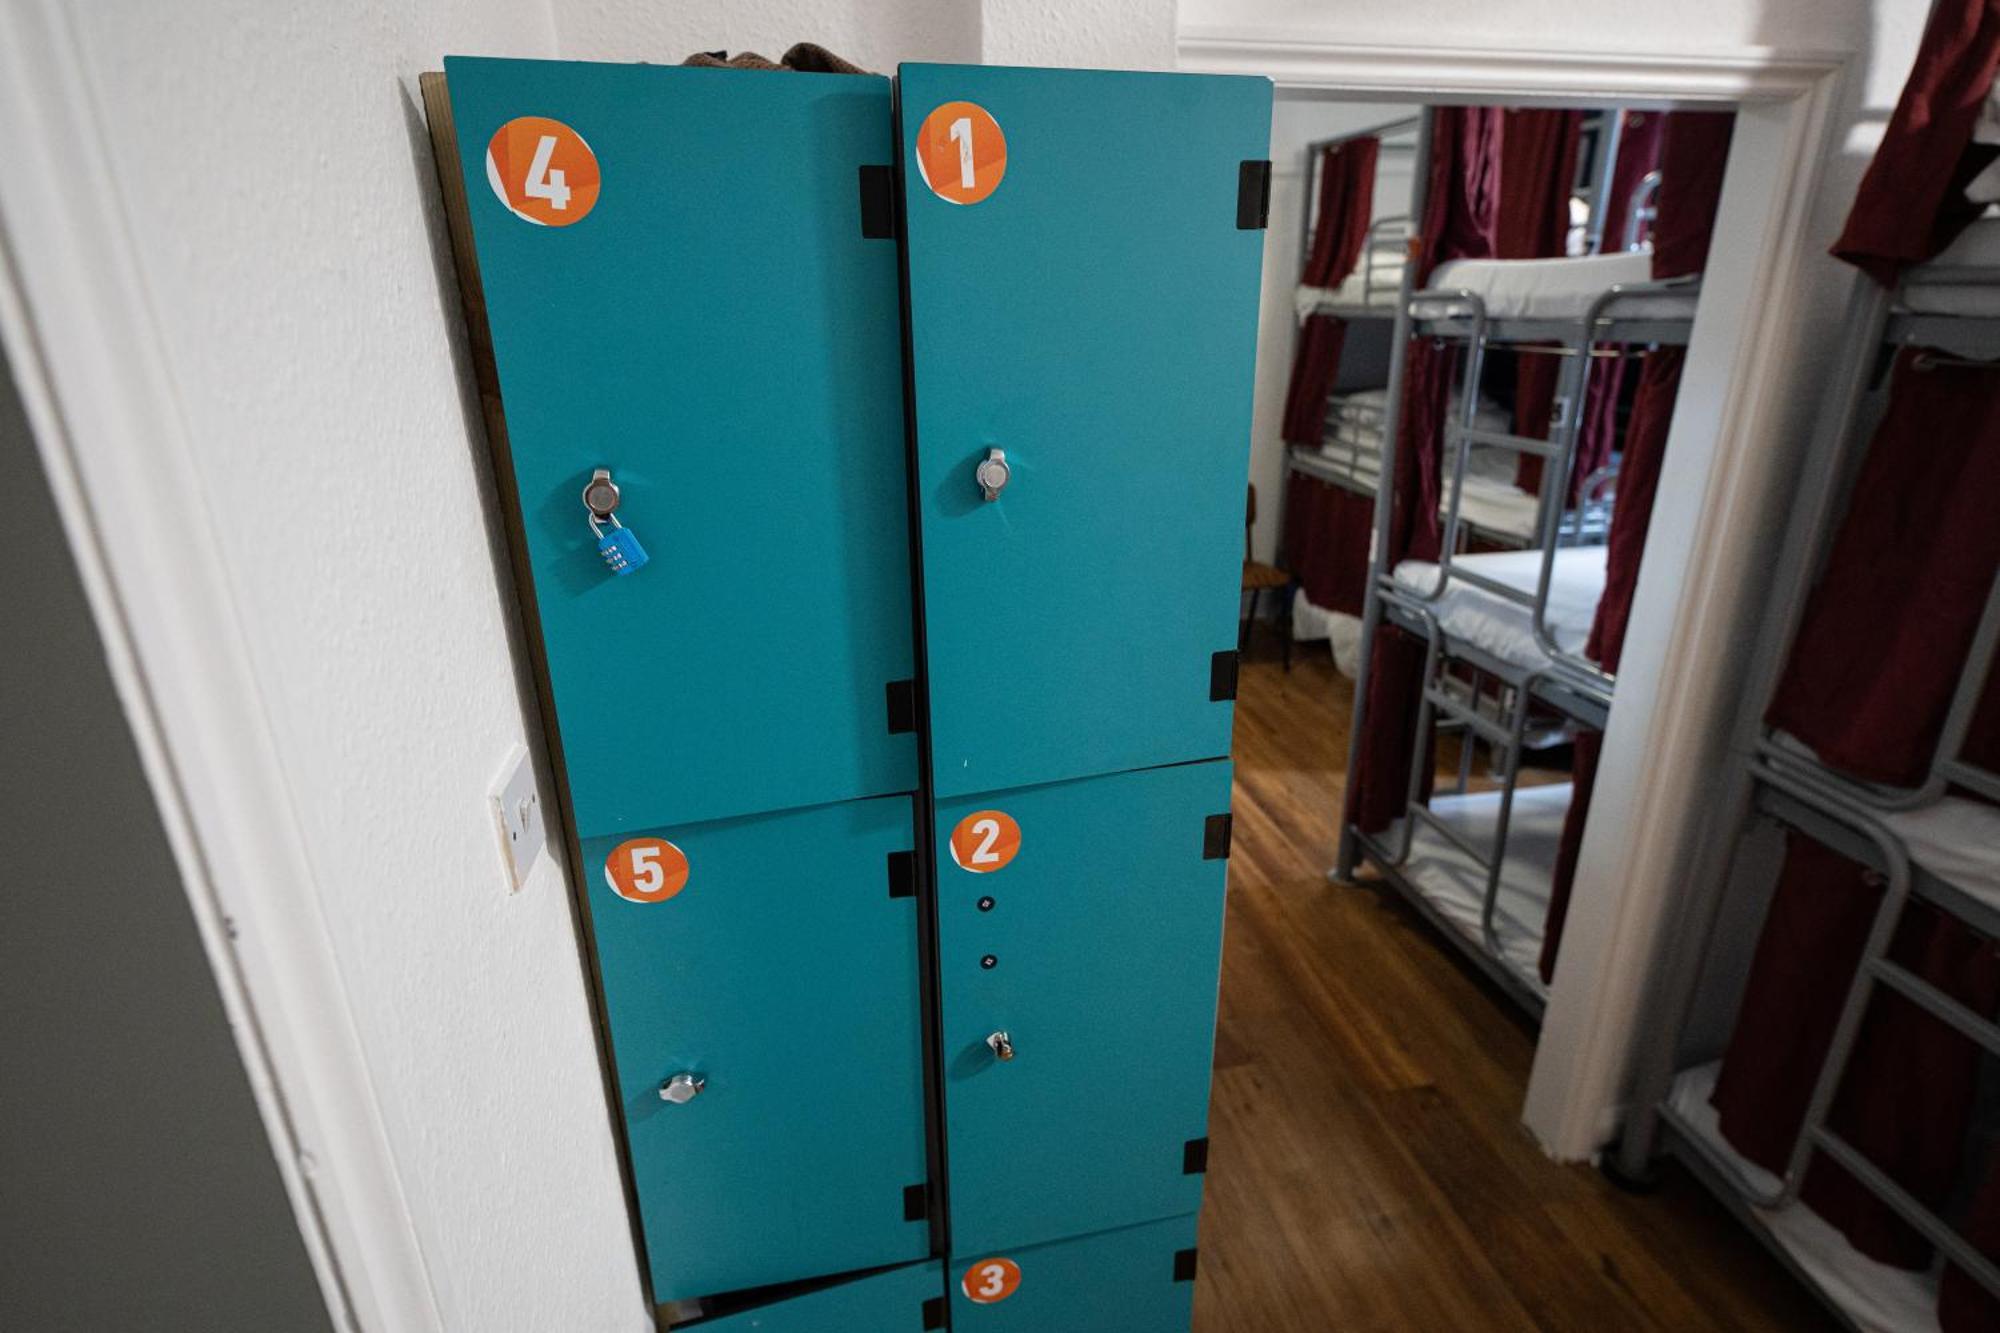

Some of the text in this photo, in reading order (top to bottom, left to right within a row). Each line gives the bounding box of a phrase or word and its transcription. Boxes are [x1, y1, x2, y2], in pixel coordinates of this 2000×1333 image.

[524, 135, 572, 211] 4
[949, 117, 976, 188] 1
[971, 819, 1000, 865] 2
[630, 846, 665, 893] 5
[979, 1264, 1005, 1297] 3
